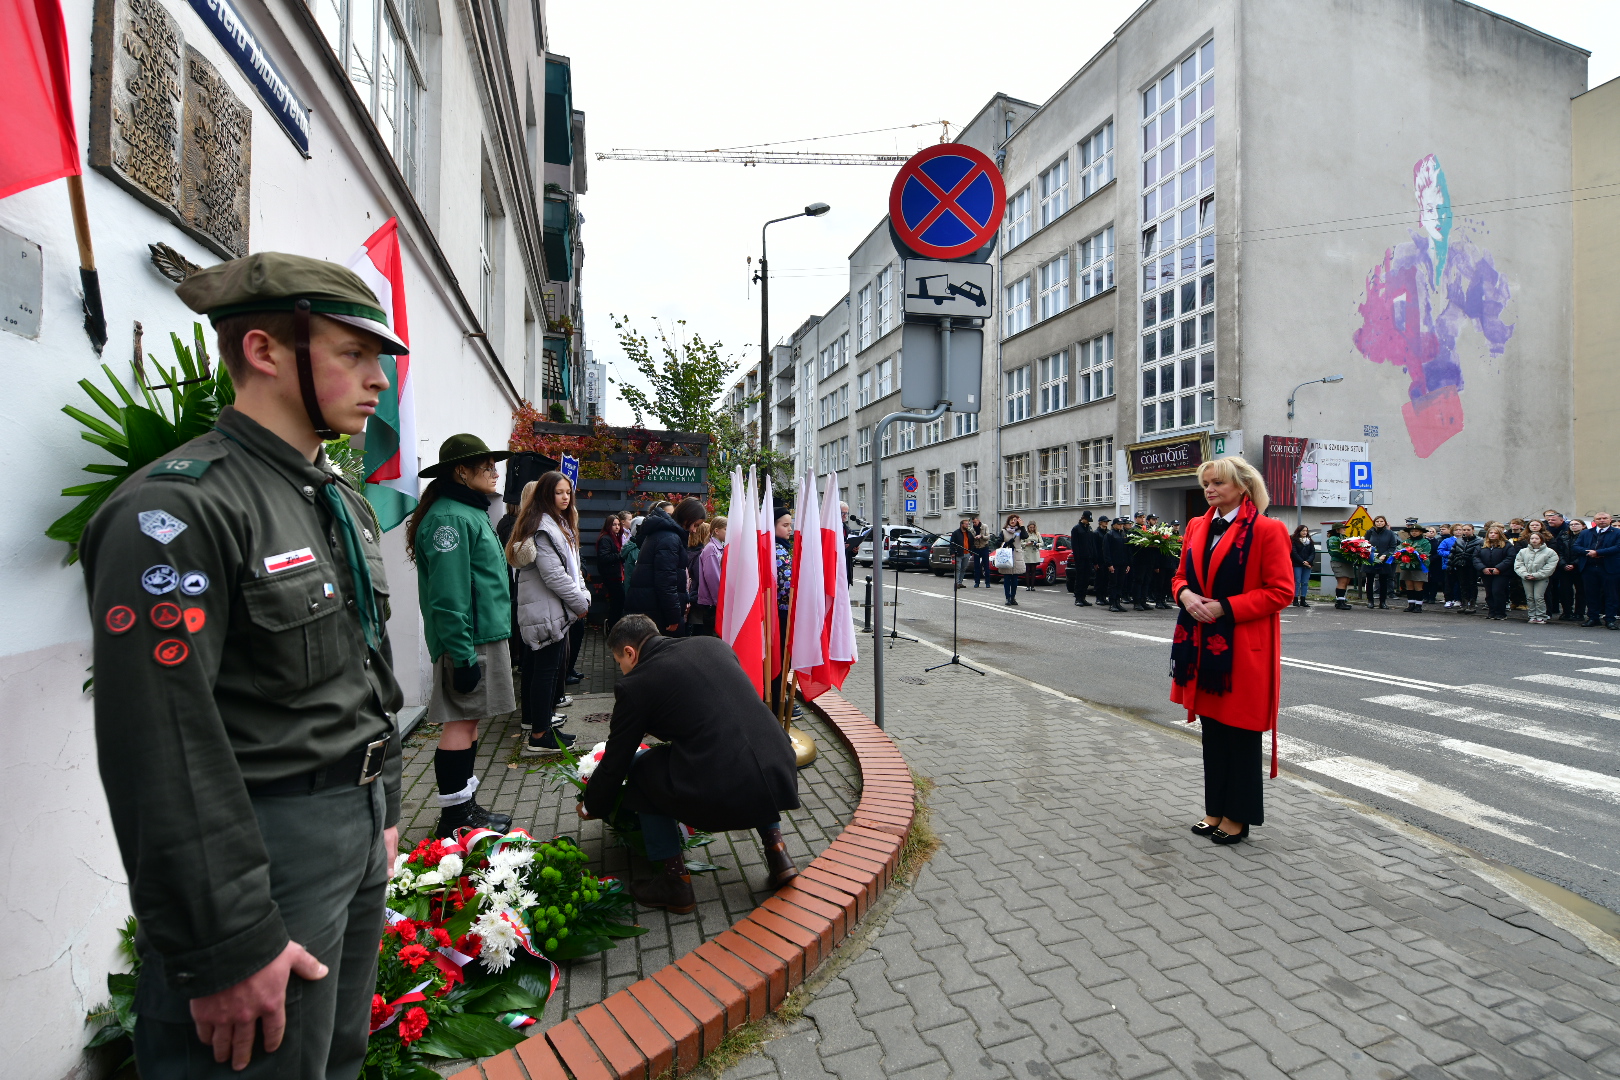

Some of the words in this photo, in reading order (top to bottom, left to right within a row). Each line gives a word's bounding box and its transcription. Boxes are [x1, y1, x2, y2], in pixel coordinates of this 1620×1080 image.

[1216, 440, 1224, 452] A
[165, 460, 193, 470] 15
[635, 464, 696, 477] GERANIUM
[1355, 465, 1367, 486] P
